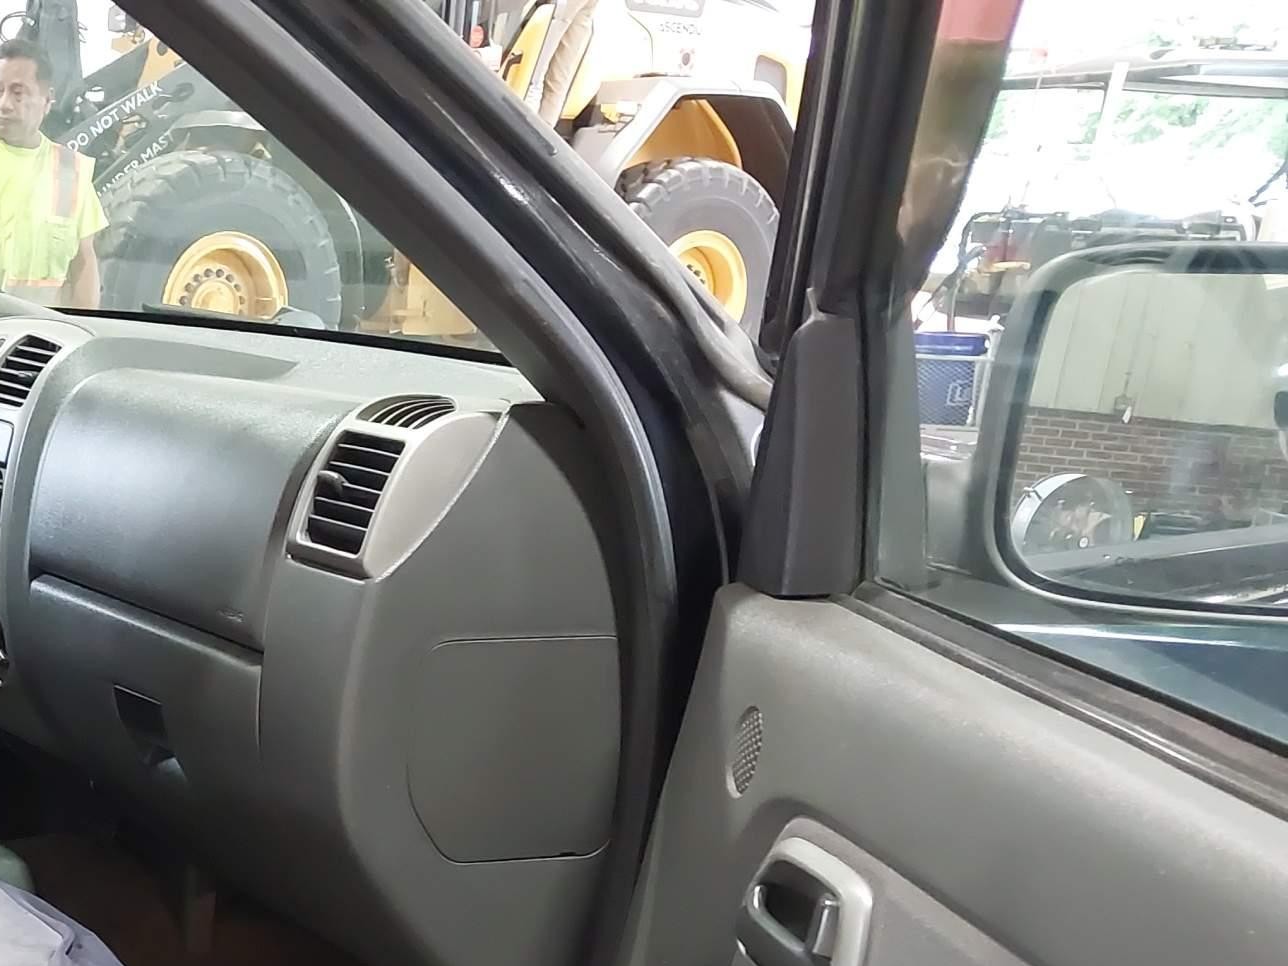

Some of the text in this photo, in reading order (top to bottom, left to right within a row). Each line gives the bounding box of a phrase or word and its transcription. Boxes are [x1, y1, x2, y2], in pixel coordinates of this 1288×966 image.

[67, 80, 164, 152] DO NOT WALK
